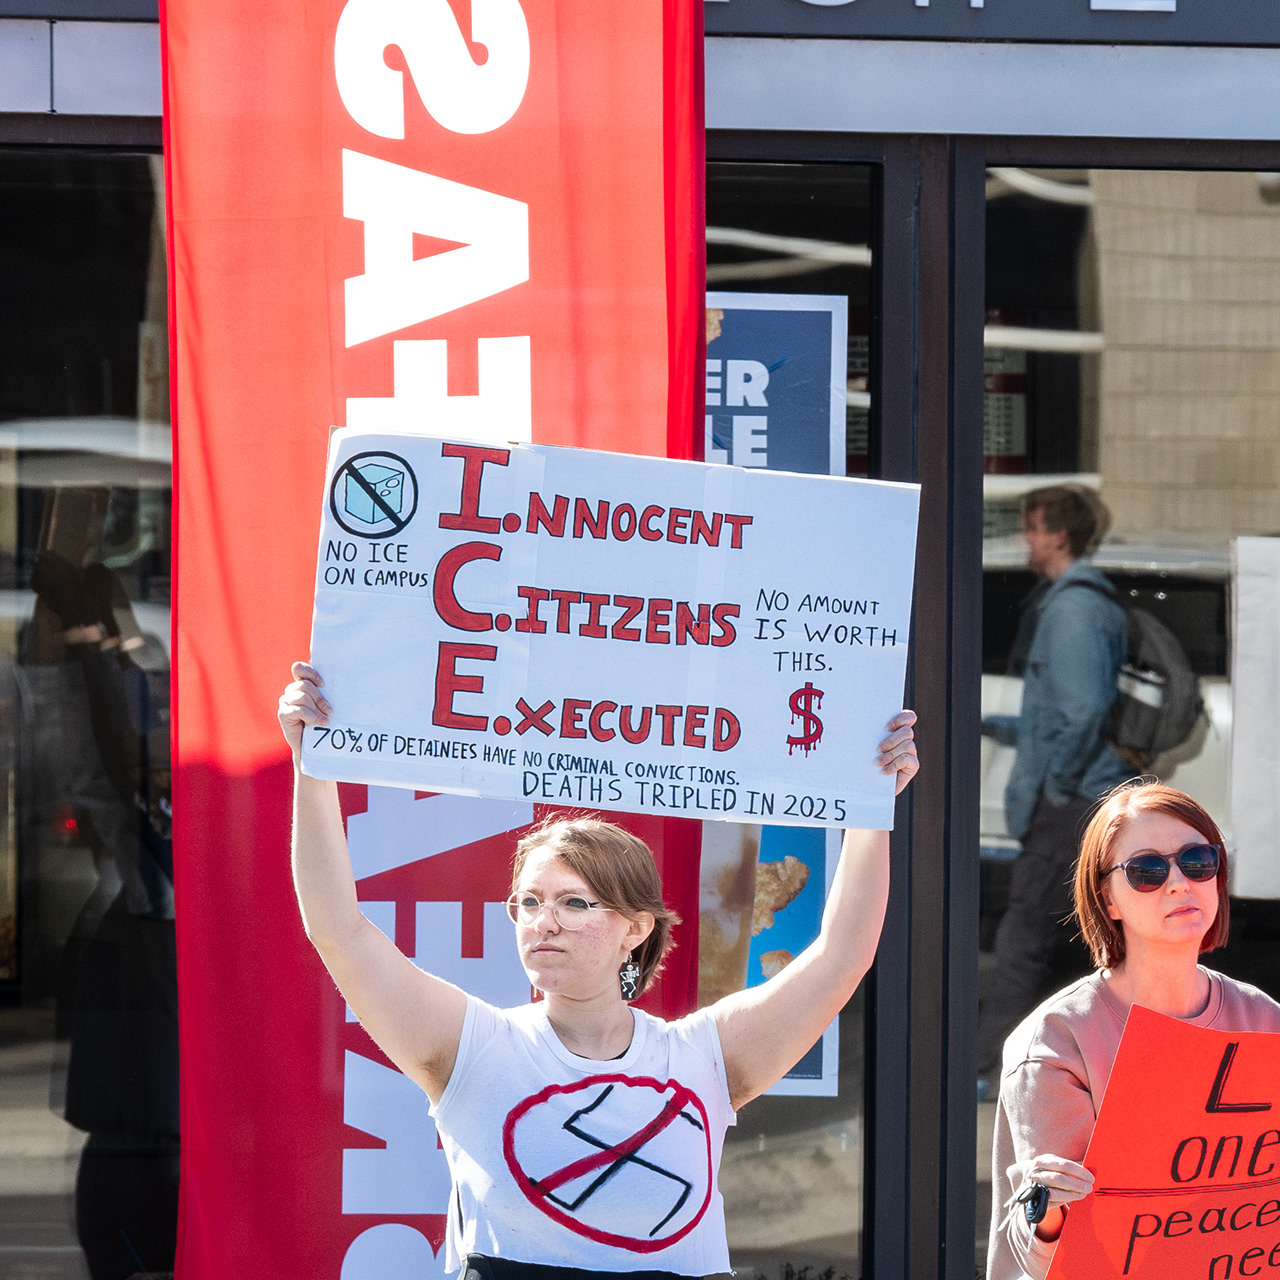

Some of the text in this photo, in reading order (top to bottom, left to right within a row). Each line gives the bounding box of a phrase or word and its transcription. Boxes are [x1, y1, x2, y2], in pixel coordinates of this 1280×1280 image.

[326, 540, 408, 564] NO ICE
[324, 566, 429, 588] ON CAMPUS
[755, 588, 880, 616] NO AMOUNT
[754, 619, 897, 648] IS WORTH
[773, 650, 834, 673] THIS.
[368, 733, 388, 752] OF
[394, 734, 477, 760] DETAINEES
[483, 744, 517, 766] HAVE
[523, 750, 543, 768] NO
[547, 752, 618, 777] CRIMINAL
[625, 761, 740, 786] CONVICTIONS.
[522, 772, 847, 822] DEATHS TRIPLED IN 2025
